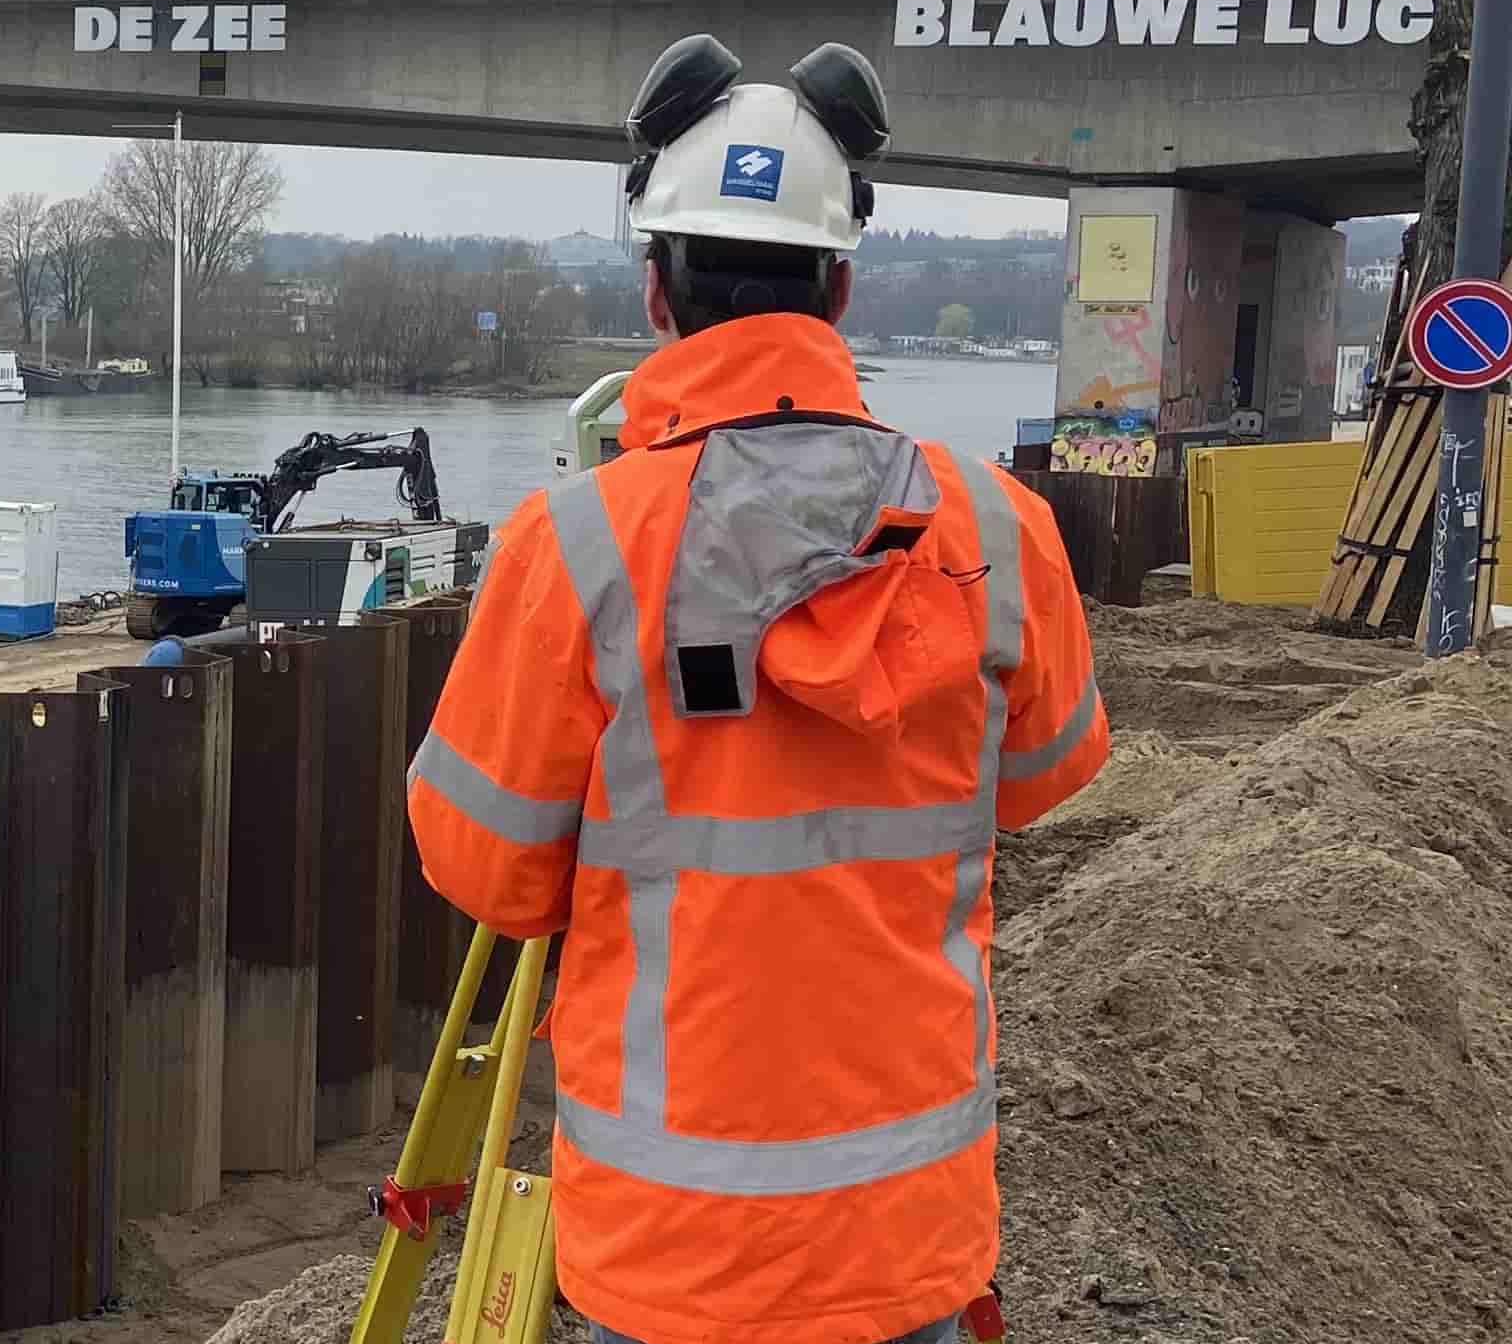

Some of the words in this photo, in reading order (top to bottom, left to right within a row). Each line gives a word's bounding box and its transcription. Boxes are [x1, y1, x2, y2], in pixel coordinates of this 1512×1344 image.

[74, 6, 152, 51] DE
[171, 4, 286, 51] ZEE
[481, 1271, 516, 1339] Leica
